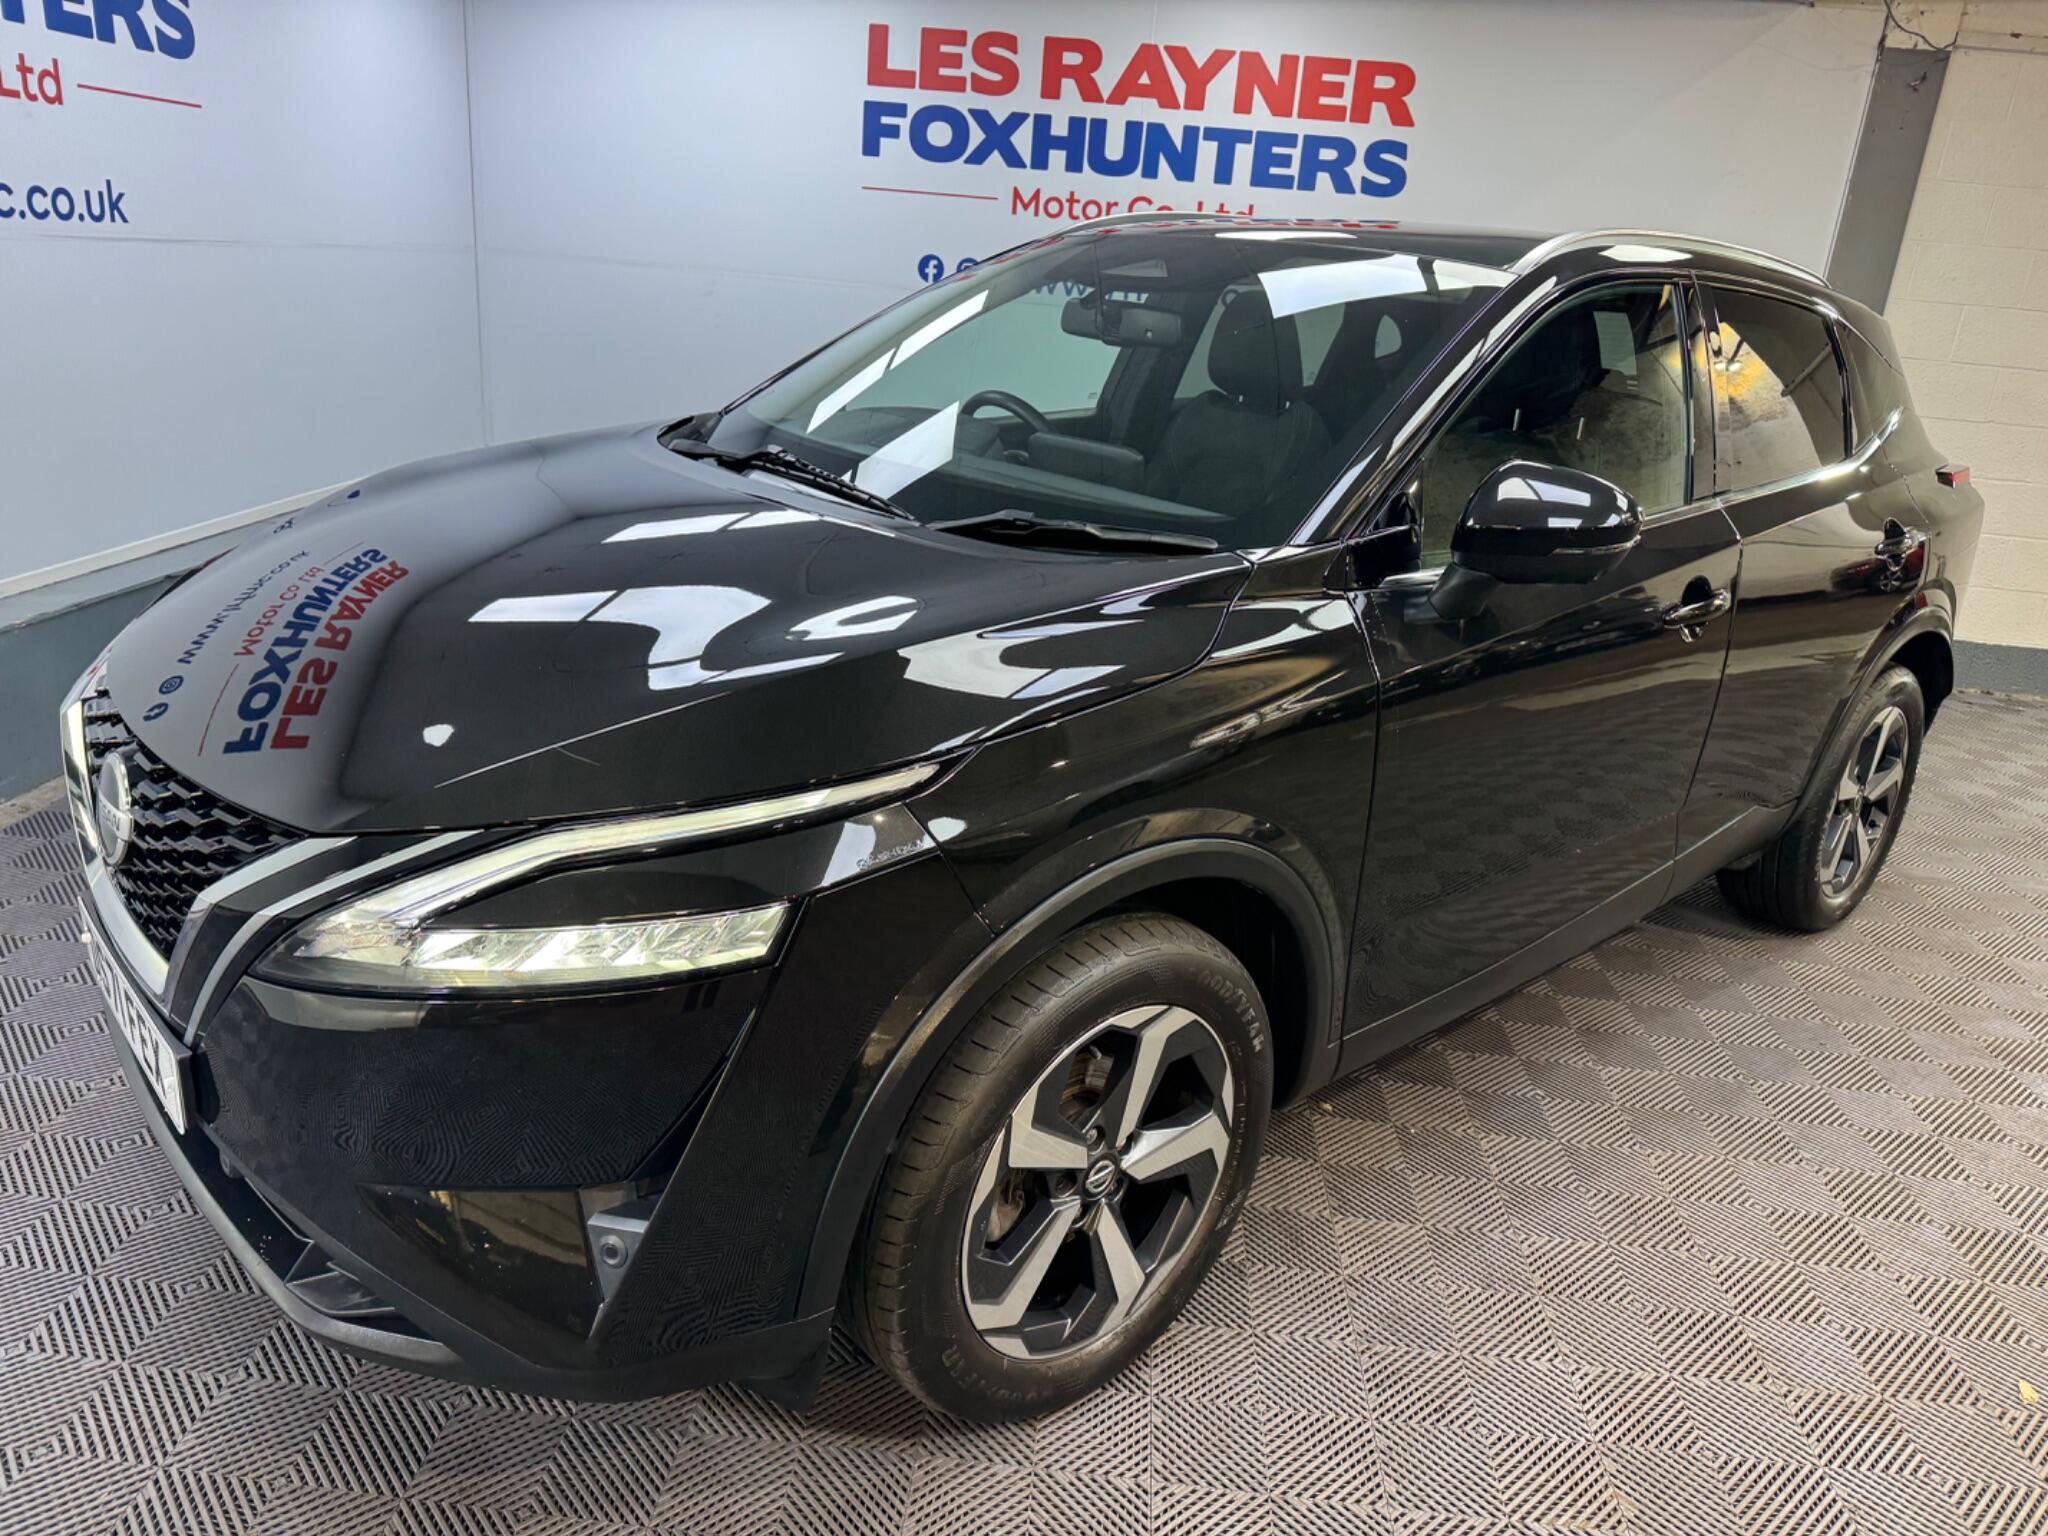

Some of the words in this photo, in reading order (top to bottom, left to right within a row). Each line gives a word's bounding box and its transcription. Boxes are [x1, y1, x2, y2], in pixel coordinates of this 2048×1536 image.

[0, 0, 195, 59] RS
[867, 23, 1020, 96] LES
[1040, 36, 1416, 127] RAYNER
[862, 100, 1408, 197] FOXHUNTERS
[1011, 186, 1118, 221] Motor
